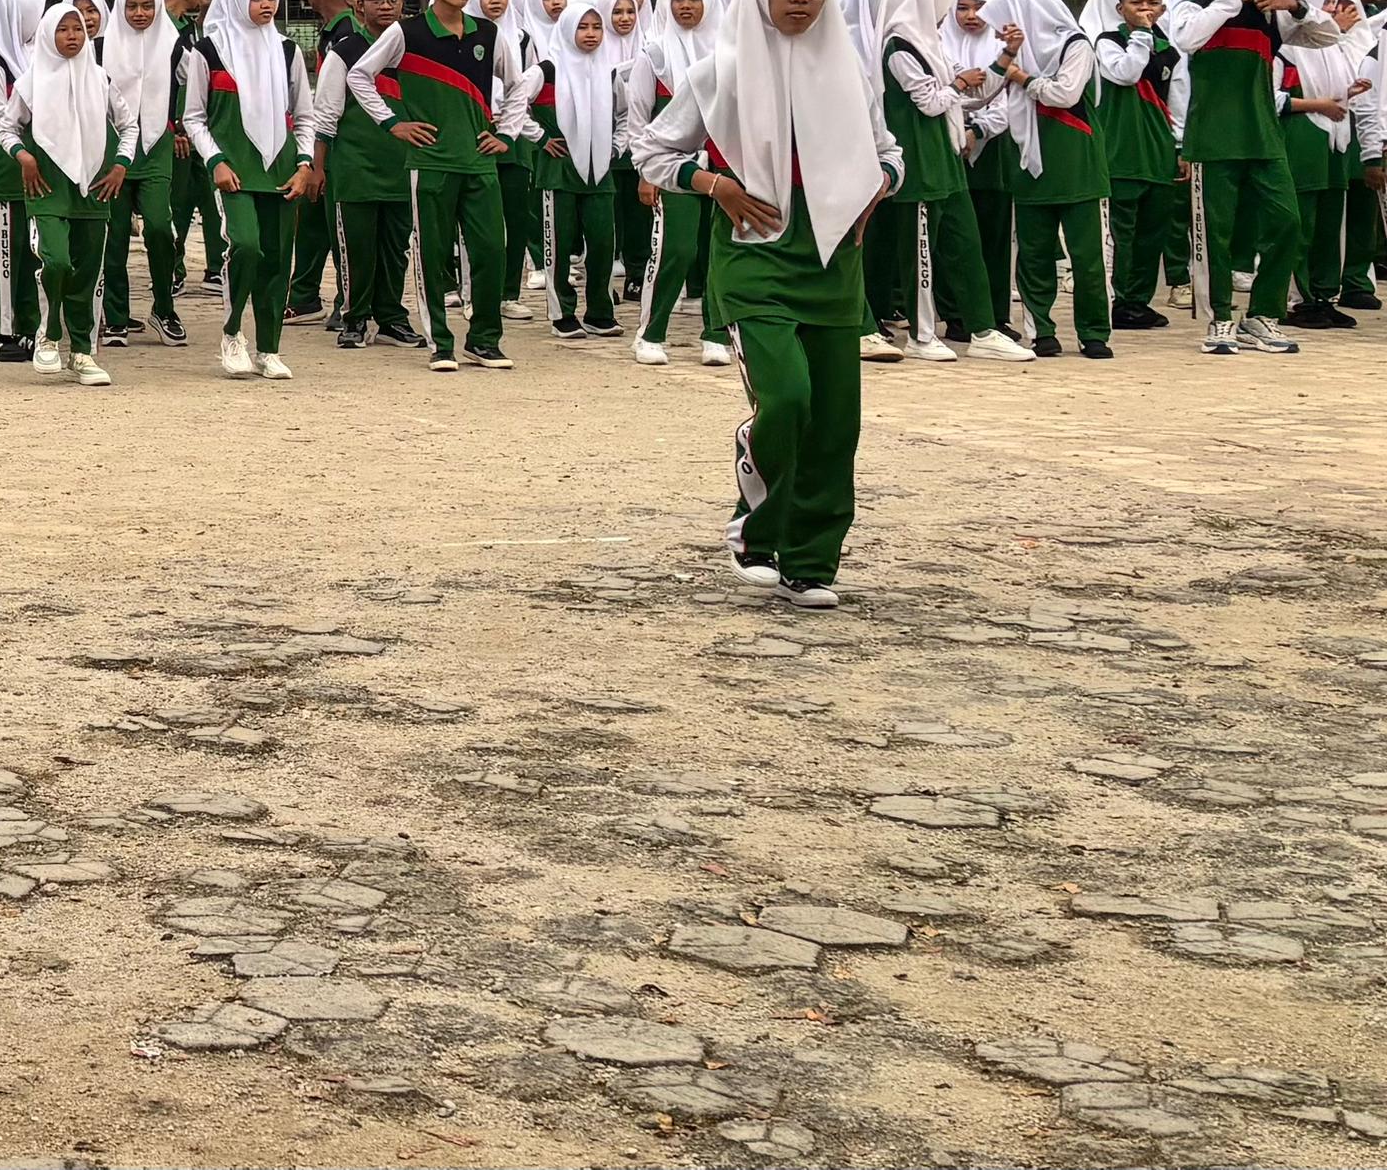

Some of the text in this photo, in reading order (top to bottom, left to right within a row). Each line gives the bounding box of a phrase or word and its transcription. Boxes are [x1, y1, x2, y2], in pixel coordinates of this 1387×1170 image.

[0, 231, 11, 279] BUNGO
[1195, 213, 1203, 263] BUNGO
[919, 239, 930, 289] BUNGO
